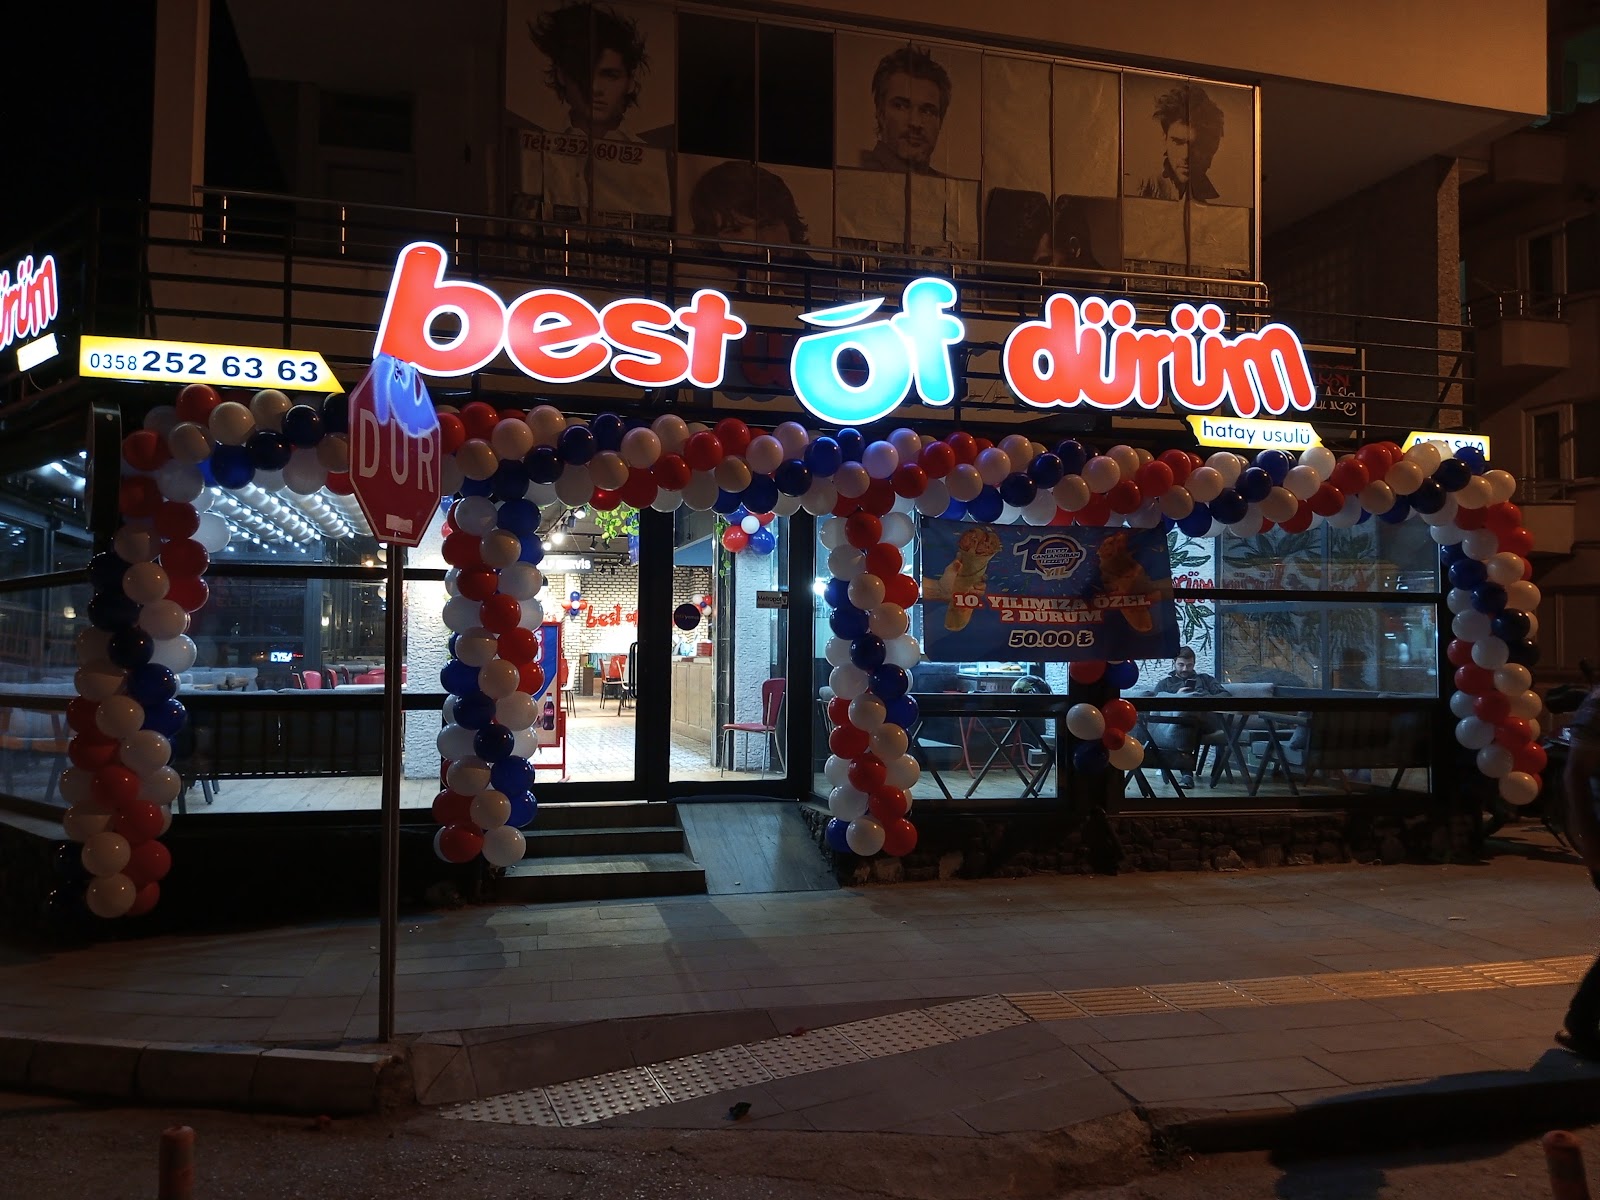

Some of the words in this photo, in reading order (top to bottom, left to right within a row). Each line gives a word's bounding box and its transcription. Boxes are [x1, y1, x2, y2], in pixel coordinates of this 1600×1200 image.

[522, 133, 551, 151] Tel:
[554, 136, 588, 156] 252
[373, 242, 747, 388] best
[1003, 293, 1316, 418] dürüm
[90, 353, 137, 371] 0358
[142, 350, 207, 375] 252
[221, 356, 263, 379] 63
[277, 360, 319, 382] 63
[1203, 420, 1256, 445] hatay
[1262, 428, 1310, 446] usulü
[359, 408, 434, 493] DUR
[954, 594, 983, 608] 10.
[987, 595, 1088, 610] YILIMIZA
[1094, 593, 1151, 609] ÖZEL
[1001, 610, 1015, 622] 2
[1019, 608, 1103, 623] DÜRÜM
[1009, 629, 1075, 648] 50.00
